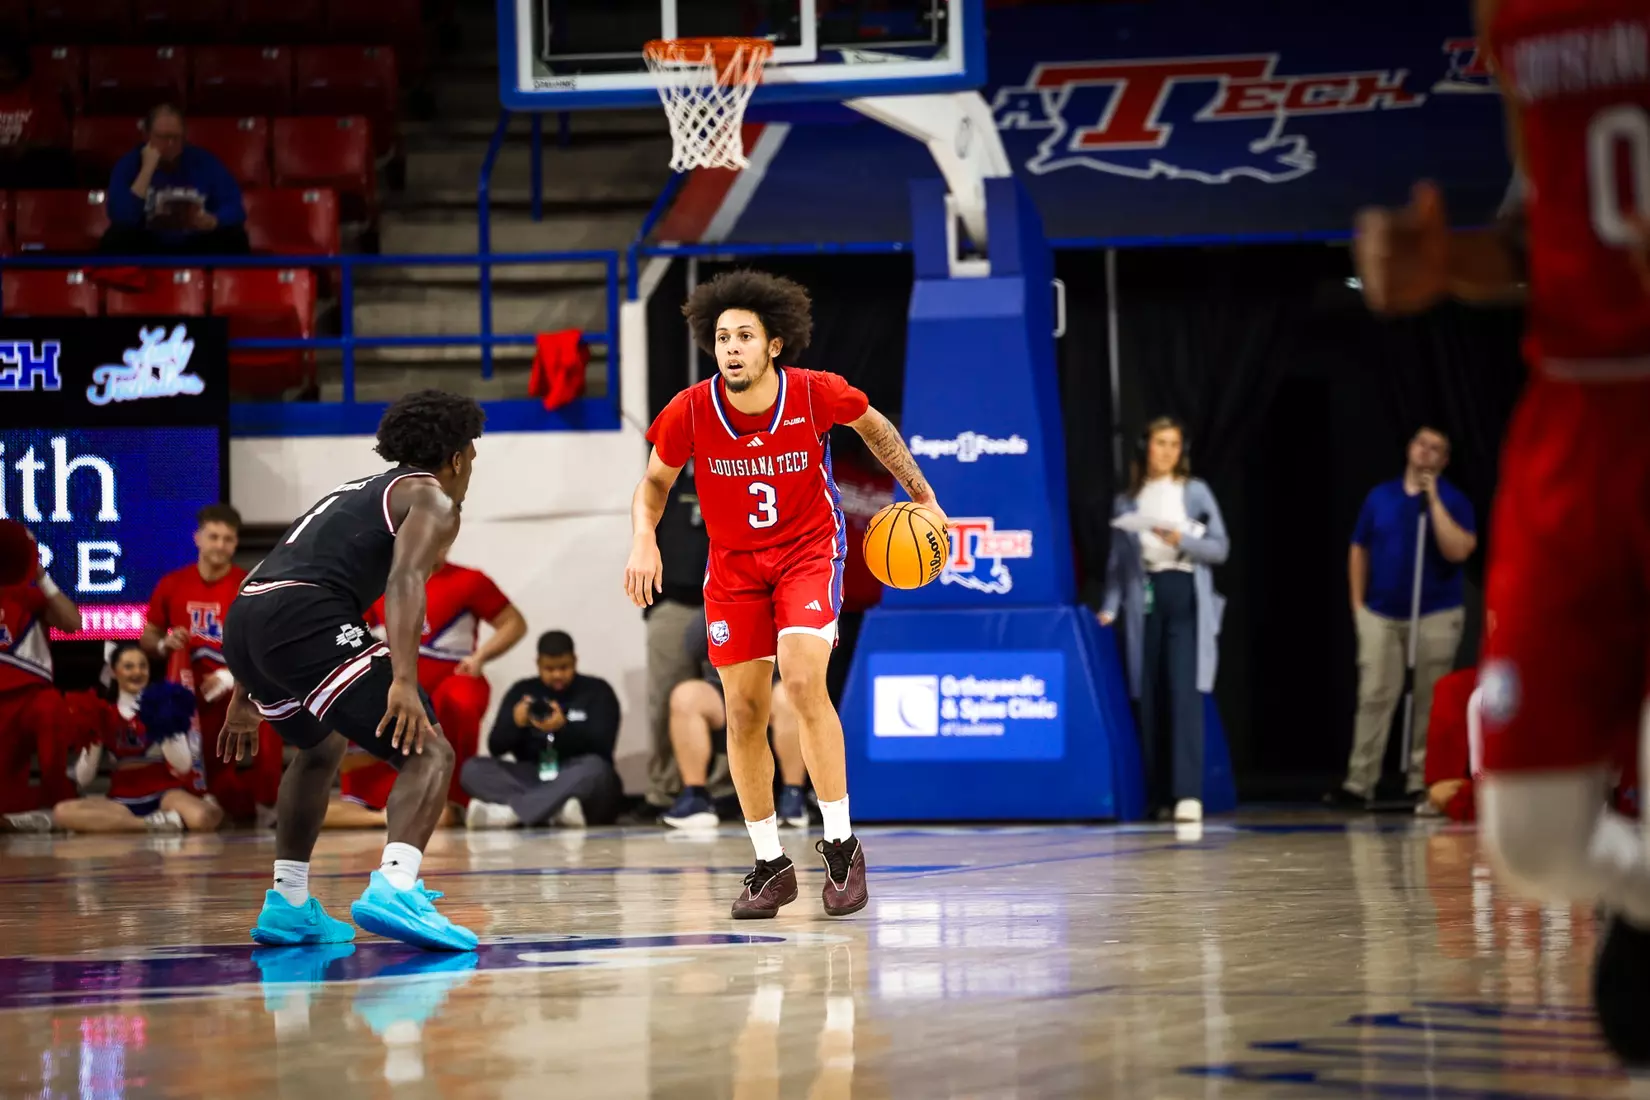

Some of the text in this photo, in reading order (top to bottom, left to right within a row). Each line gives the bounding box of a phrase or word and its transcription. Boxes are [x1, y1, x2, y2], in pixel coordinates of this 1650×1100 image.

[708, 451, 808, 476] LOUISIANA TECH
[748, 481, 778, 529] 3
[925, 530, 942, 582] Wilson
[1008, 697, 1057, 719] Clinic
